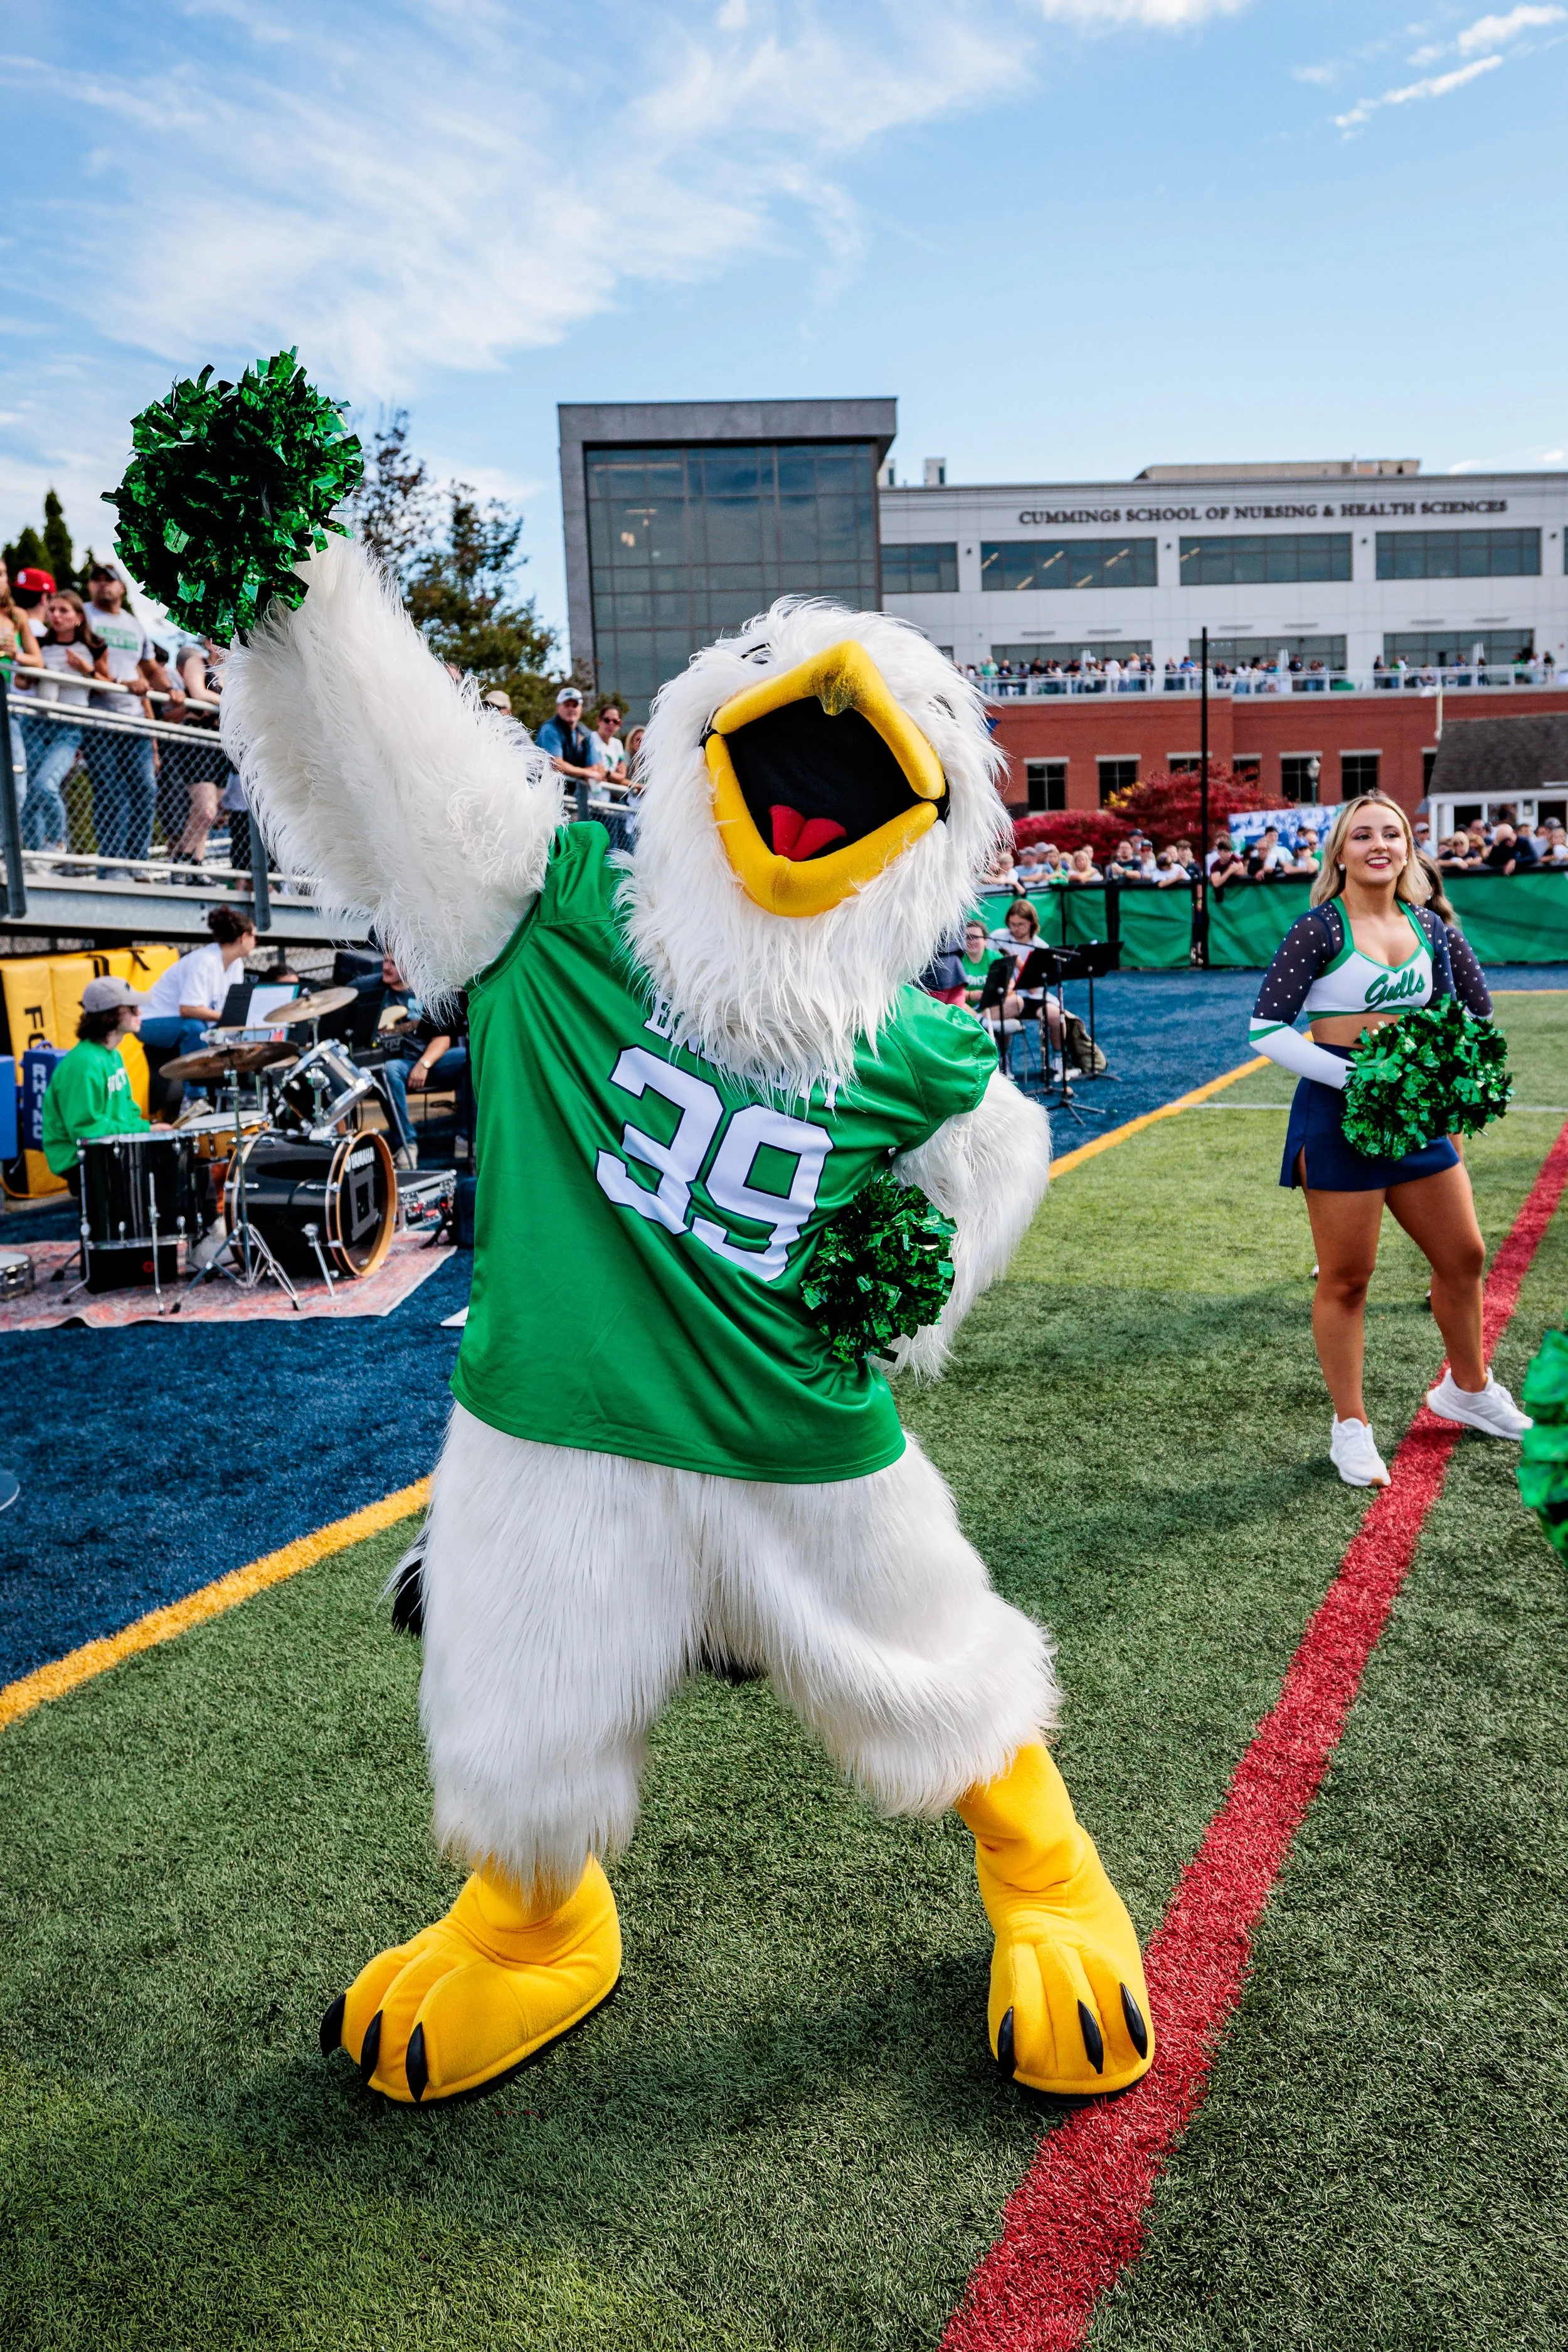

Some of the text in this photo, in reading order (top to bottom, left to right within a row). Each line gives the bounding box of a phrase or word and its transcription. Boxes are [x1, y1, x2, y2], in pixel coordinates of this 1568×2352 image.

[1019, 499, 1507, 524] CUMMINGS SCHOOL OF NURSING & HEALTH SCIENCES
[1364, 967, 1426, 1012] Gulls
[350, 1146, 376, 1170] YAMAHA
[594, 1044, 835, 1283] 39
